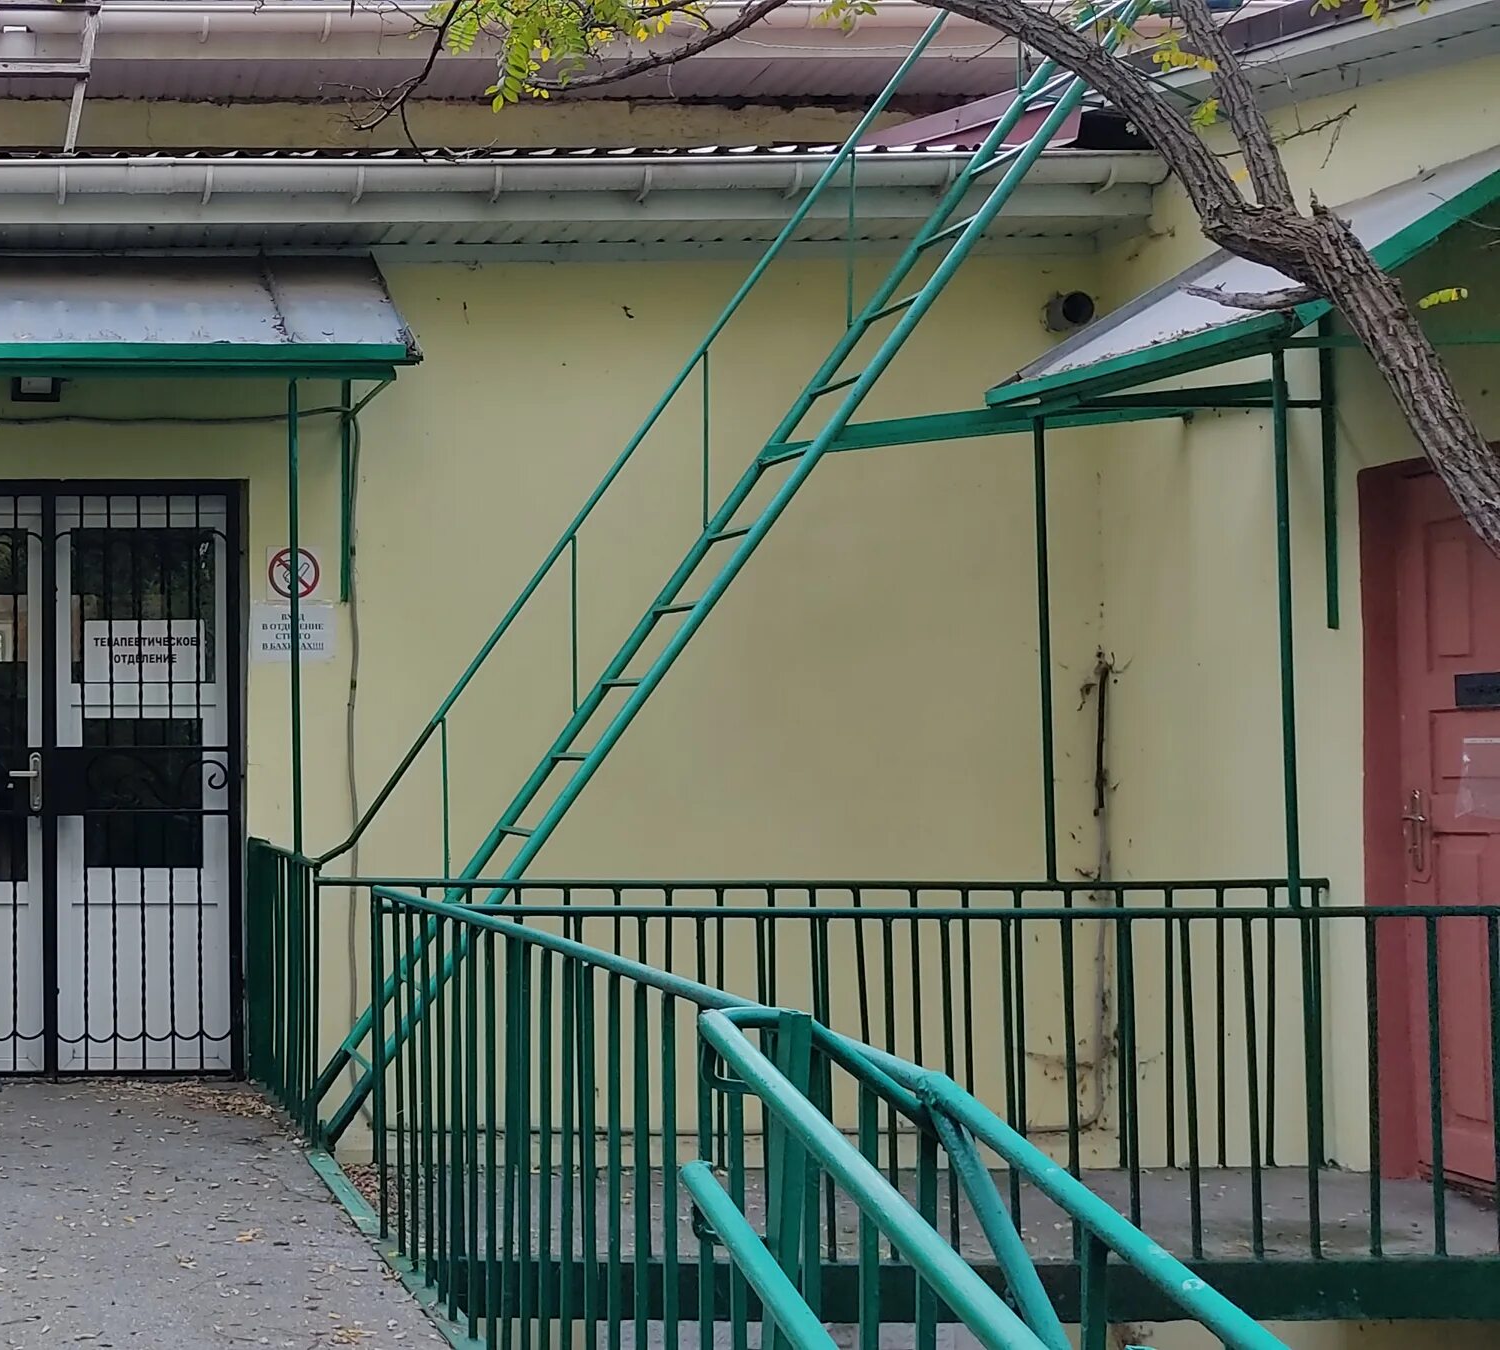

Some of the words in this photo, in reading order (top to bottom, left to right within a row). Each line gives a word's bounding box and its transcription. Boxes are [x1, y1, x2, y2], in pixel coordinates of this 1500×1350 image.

[281, 613, 305, 621] ВД
[262, 623, 268, 631] В
[269, 623, 324, 632] ОТДЕНИЕ
[275, 632, 311, 640] СТГО
[262, 642, 268, 650] В
[269, 642, 324, 651] БАХАХ!!!!
